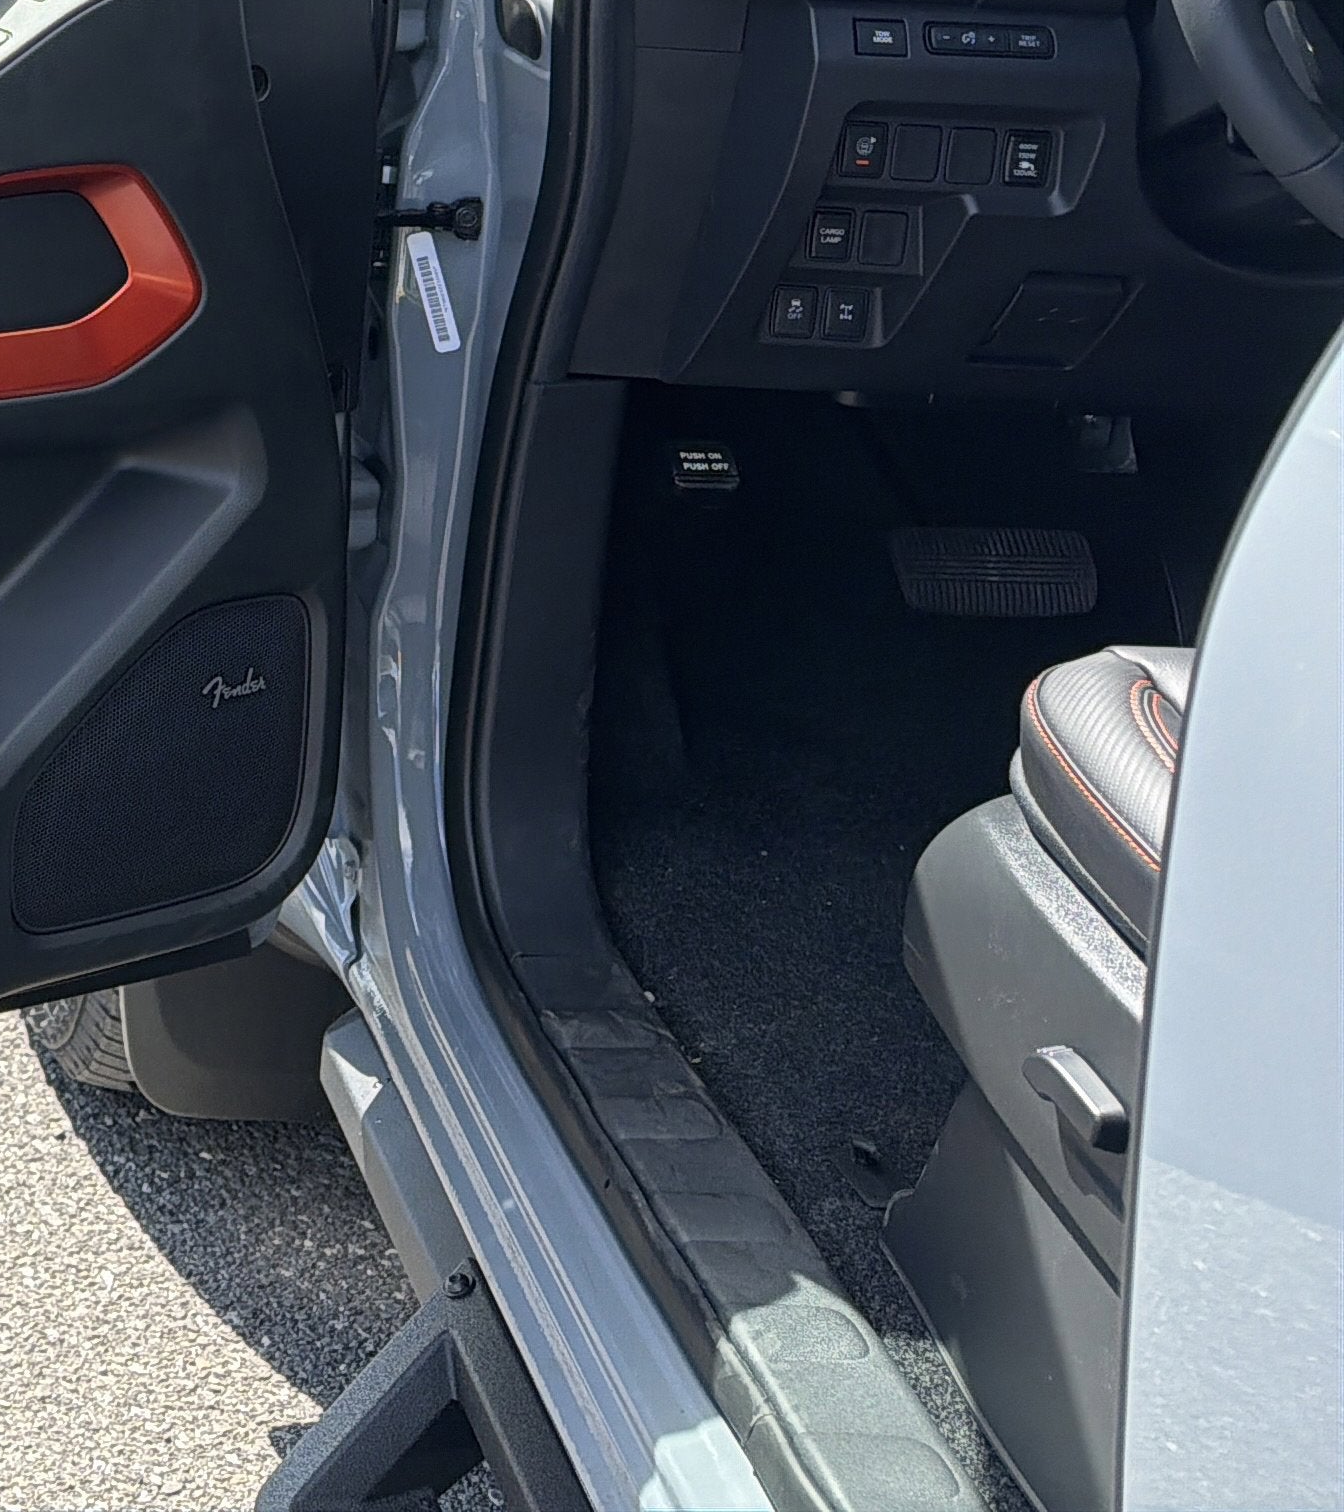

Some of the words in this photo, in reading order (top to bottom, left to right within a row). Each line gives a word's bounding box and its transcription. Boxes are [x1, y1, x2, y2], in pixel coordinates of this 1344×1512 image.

[873, 36, 894, 44] MODE
[819, 228, 845, 236] CARGO
[820, 236, 842, 244] LAMP
[201, 667, 266, 709] Fender
